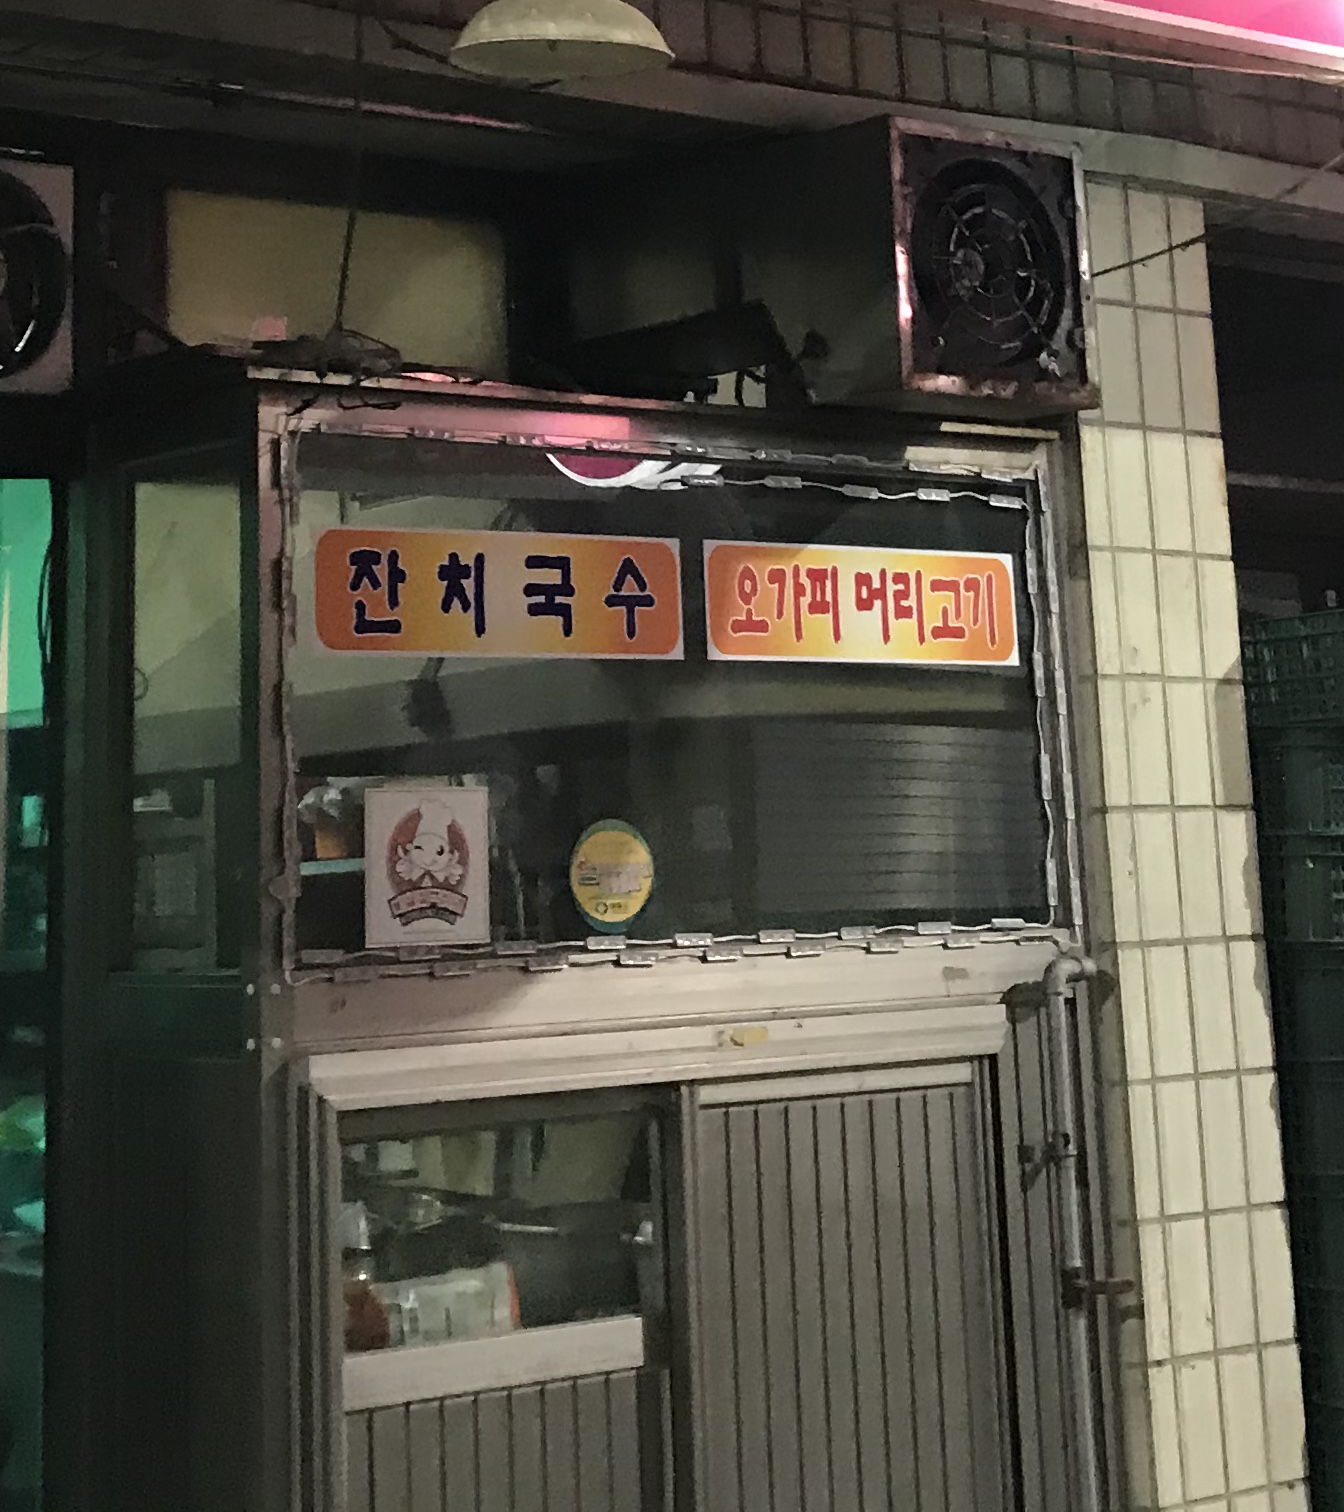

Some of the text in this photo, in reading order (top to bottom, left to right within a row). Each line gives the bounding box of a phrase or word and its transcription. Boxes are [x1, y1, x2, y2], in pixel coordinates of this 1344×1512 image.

[346, 547, 656, 640] 잔치국수
[728, 564, 998, 648] 오가피 머리고기
